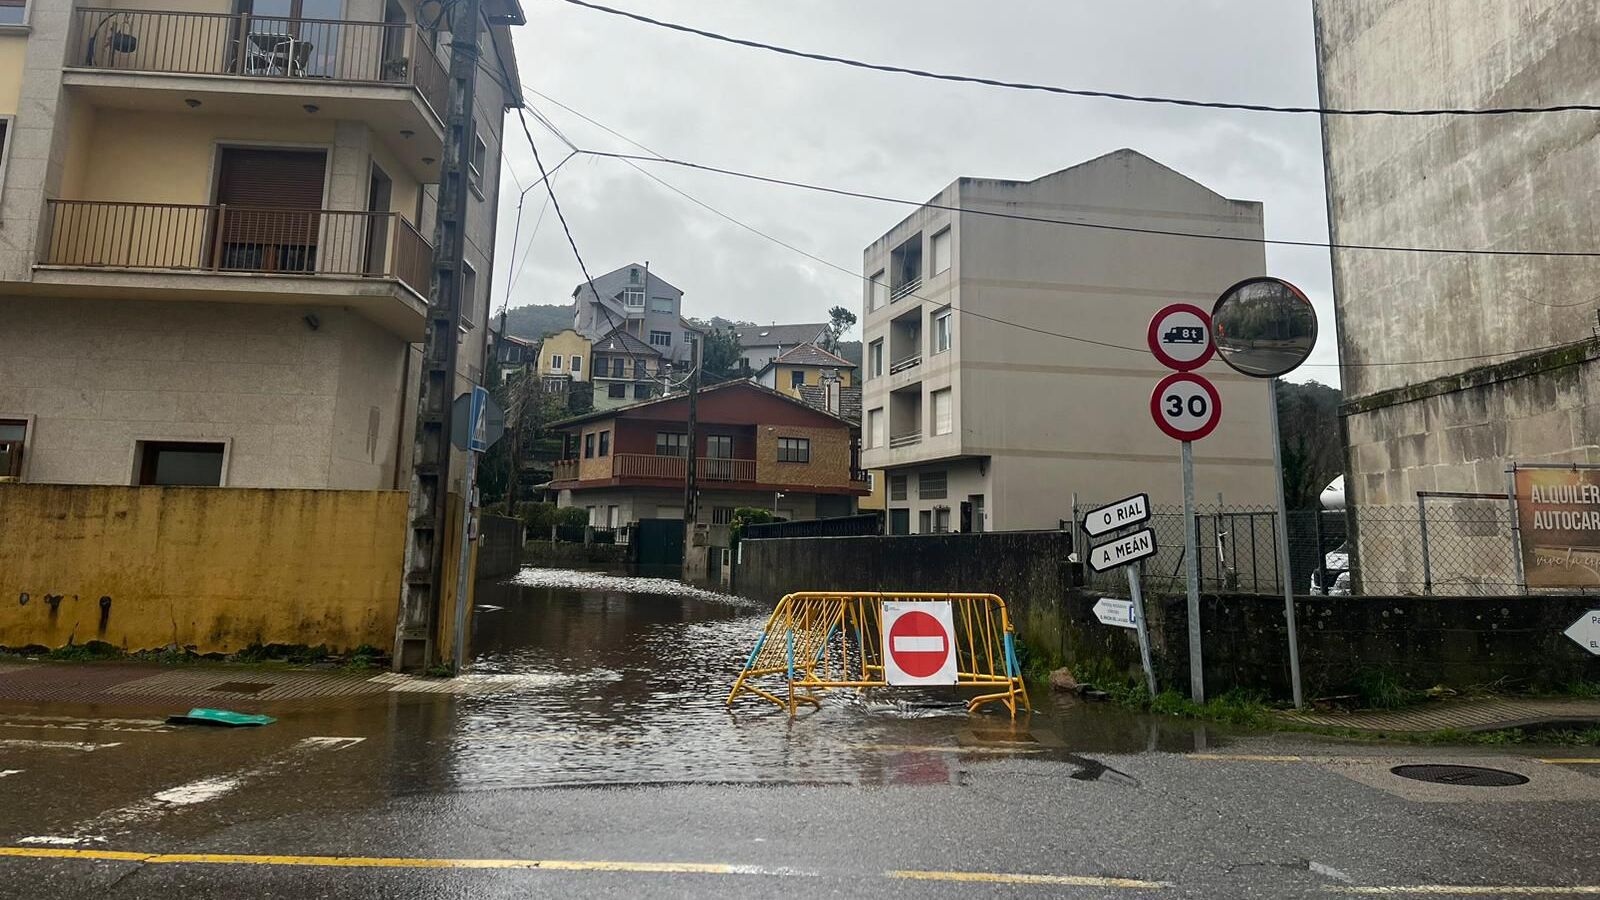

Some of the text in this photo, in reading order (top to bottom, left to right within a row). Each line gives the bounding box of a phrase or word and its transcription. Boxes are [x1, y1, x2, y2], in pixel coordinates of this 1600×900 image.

[1166, 394, 1207, 417] 30
[1531, 484, 1600, 504] ALQUILER
[1103, 502, 1143, 525] O RIAL
[1534, 510, 1600, 531] AUTOCAR
[1103, 536, 1149, 563] A MEÁN
[1589, 640, 1599, 648] EL
